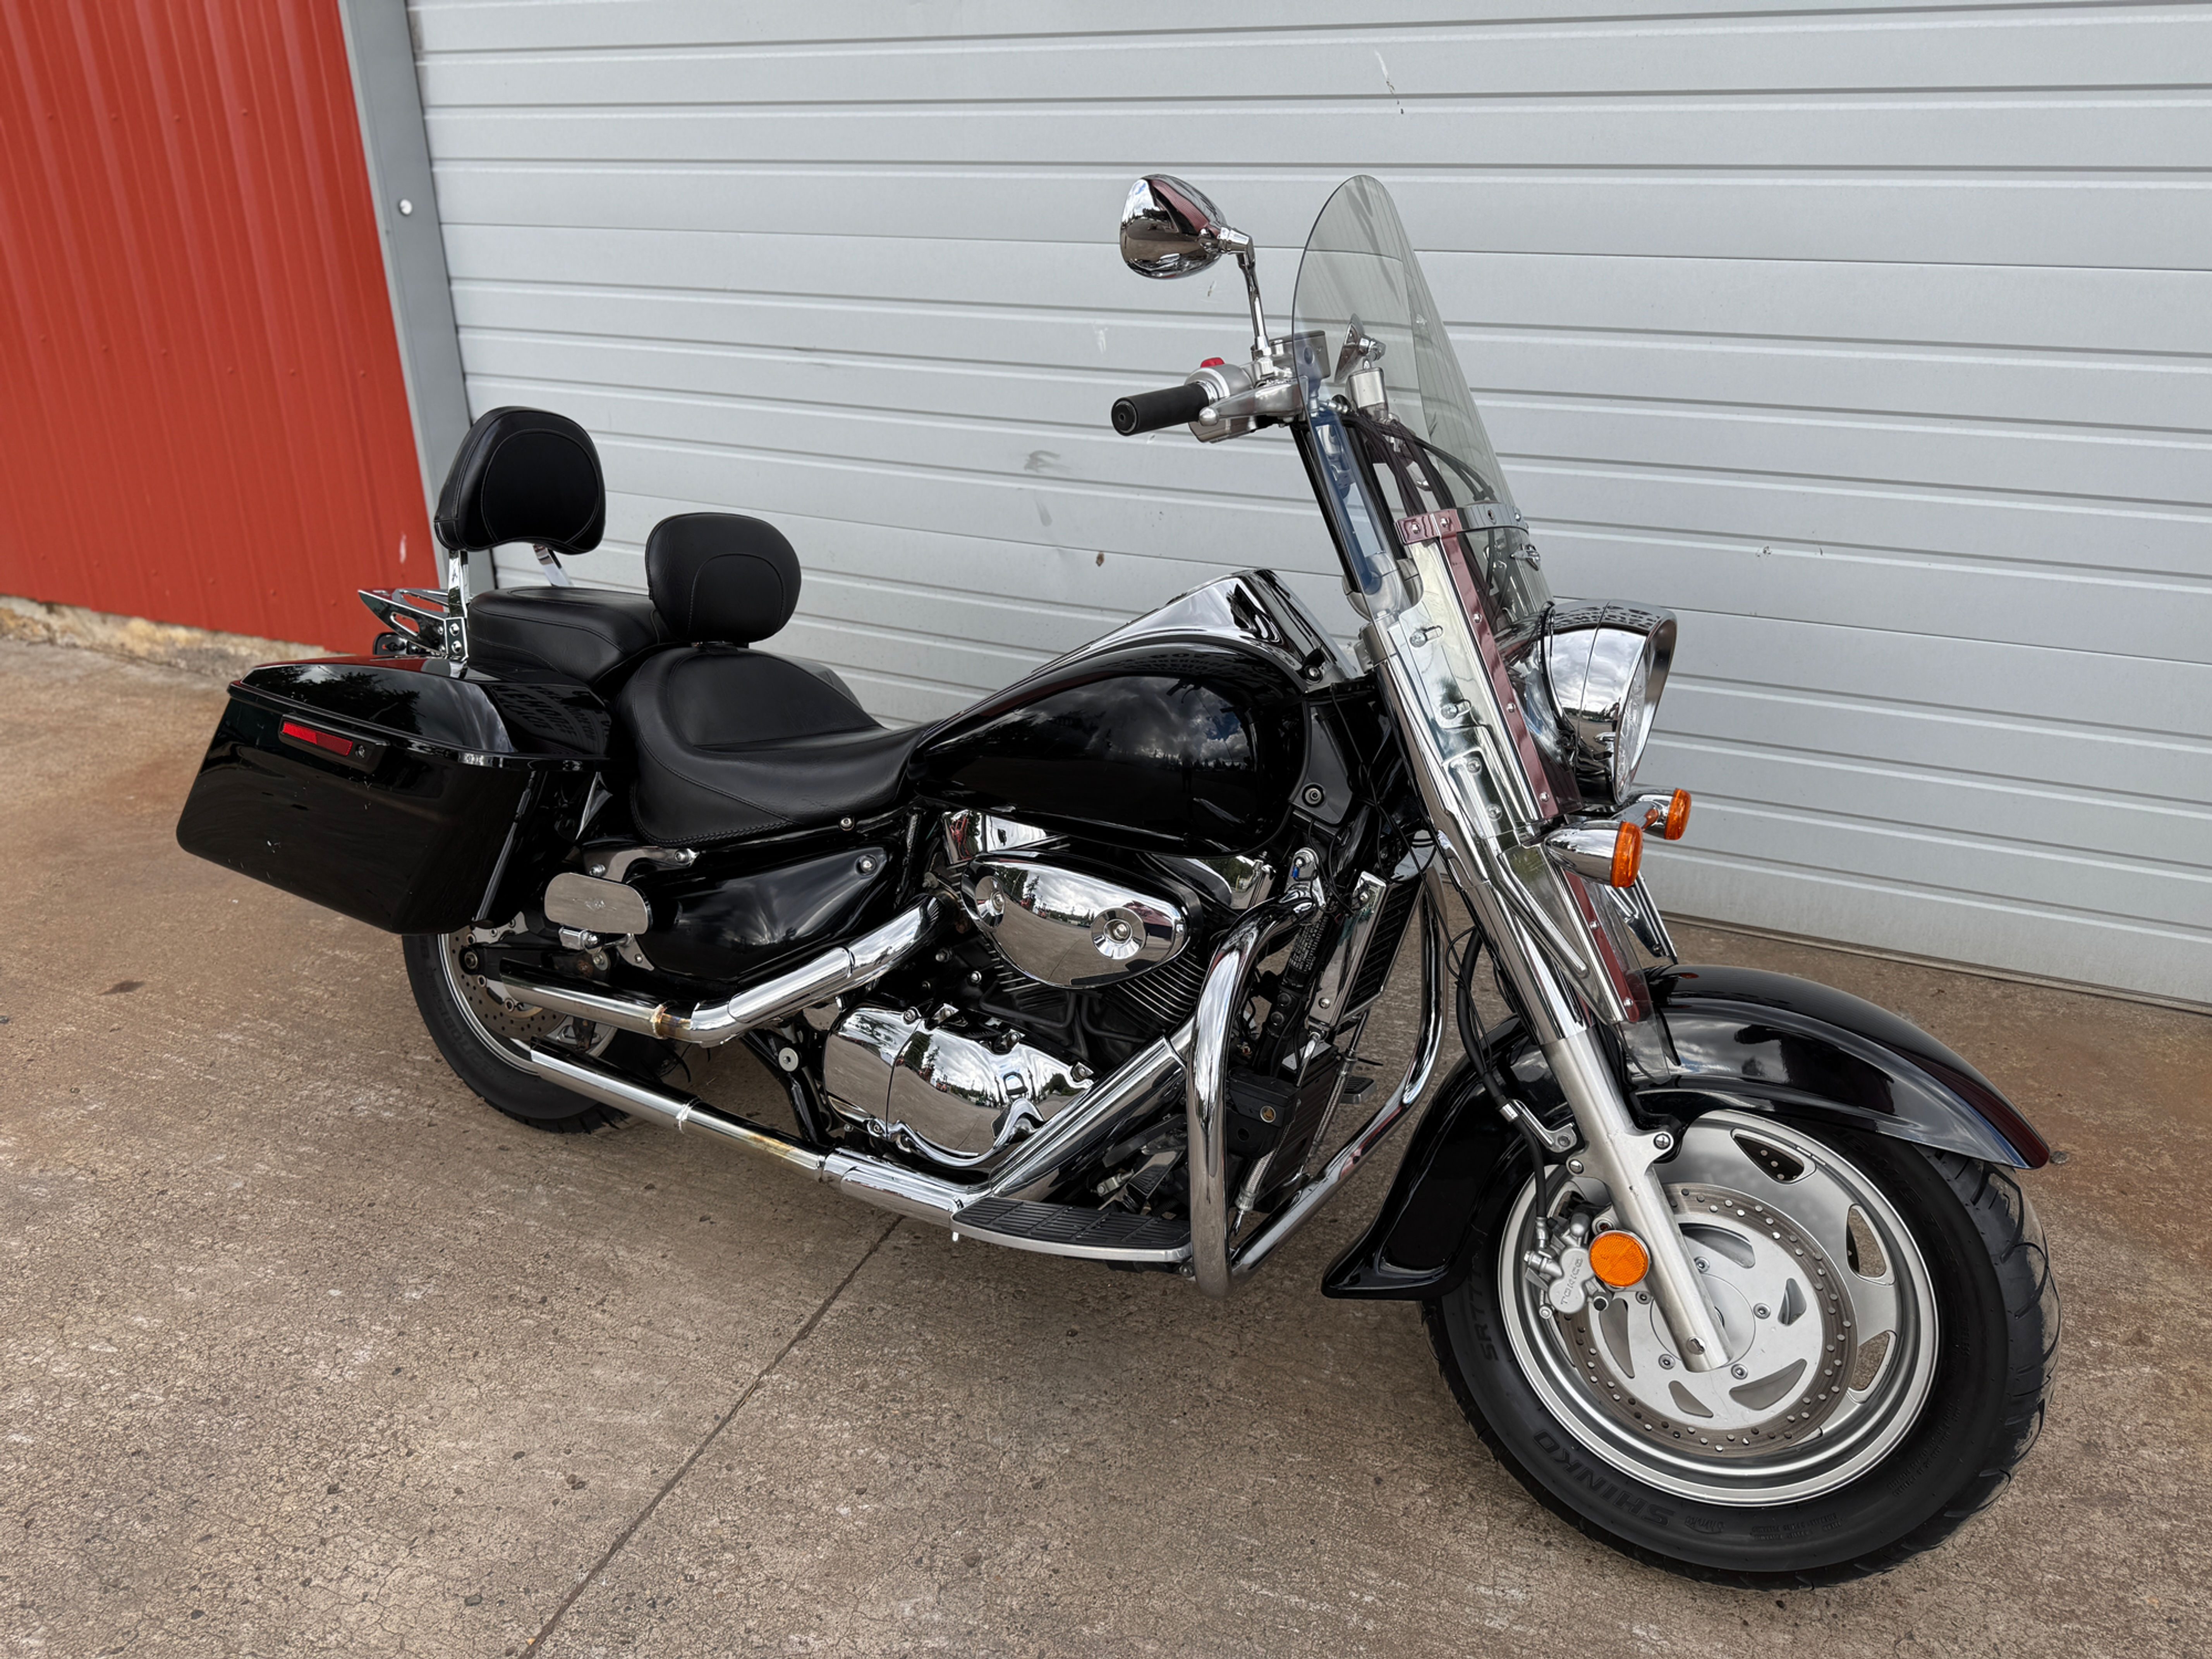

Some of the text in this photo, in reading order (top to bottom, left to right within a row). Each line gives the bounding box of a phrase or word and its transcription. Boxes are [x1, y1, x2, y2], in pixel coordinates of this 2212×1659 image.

[1468, 1267, 1500, 1361] SR777
[1560, 1257, 1583, 1305] TOKICO
[1531, 1429, 1677, 1527] SHINKO
